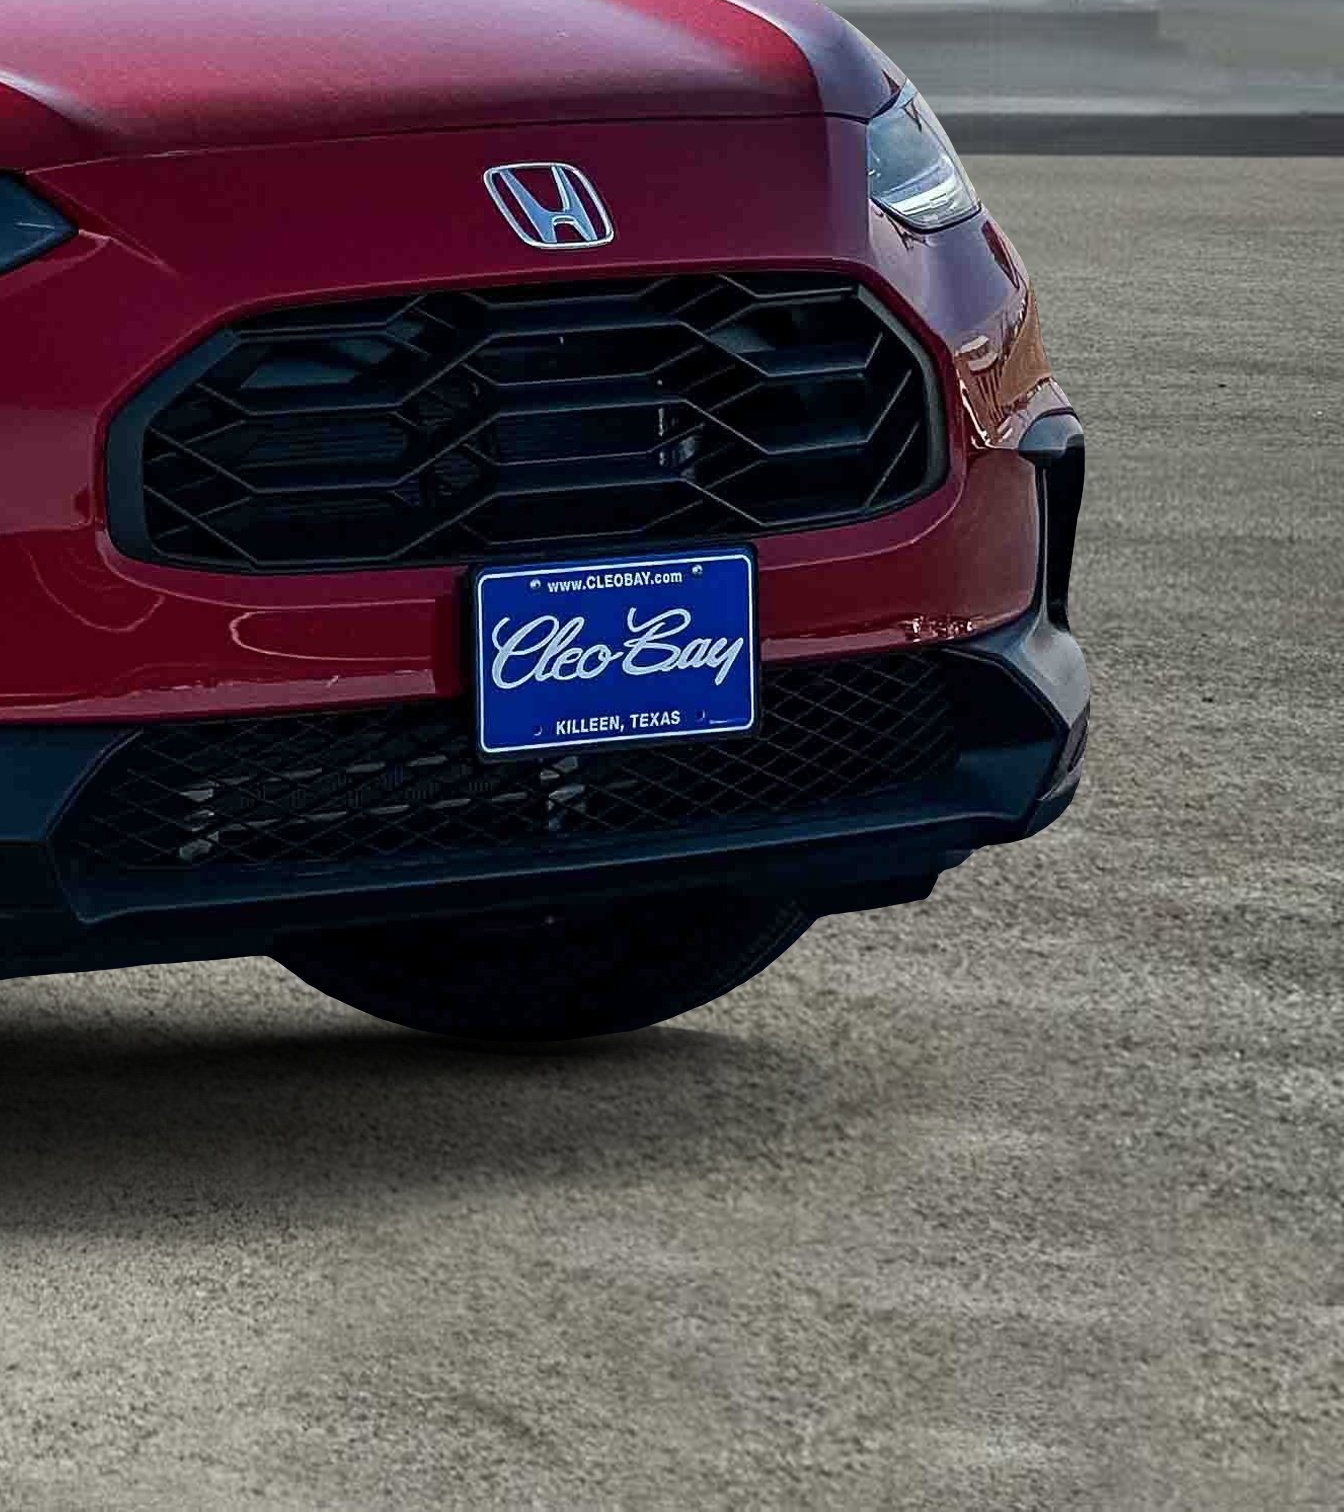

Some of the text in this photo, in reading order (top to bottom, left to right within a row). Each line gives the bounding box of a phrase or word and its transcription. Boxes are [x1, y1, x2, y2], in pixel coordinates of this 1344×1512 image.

[546, 570, 683, 593] www.CLEOBAY.com
[491, 606, 744, 690] Cleo Bay
[555, 709, 682, 736] KILLEEN, TEXAS
